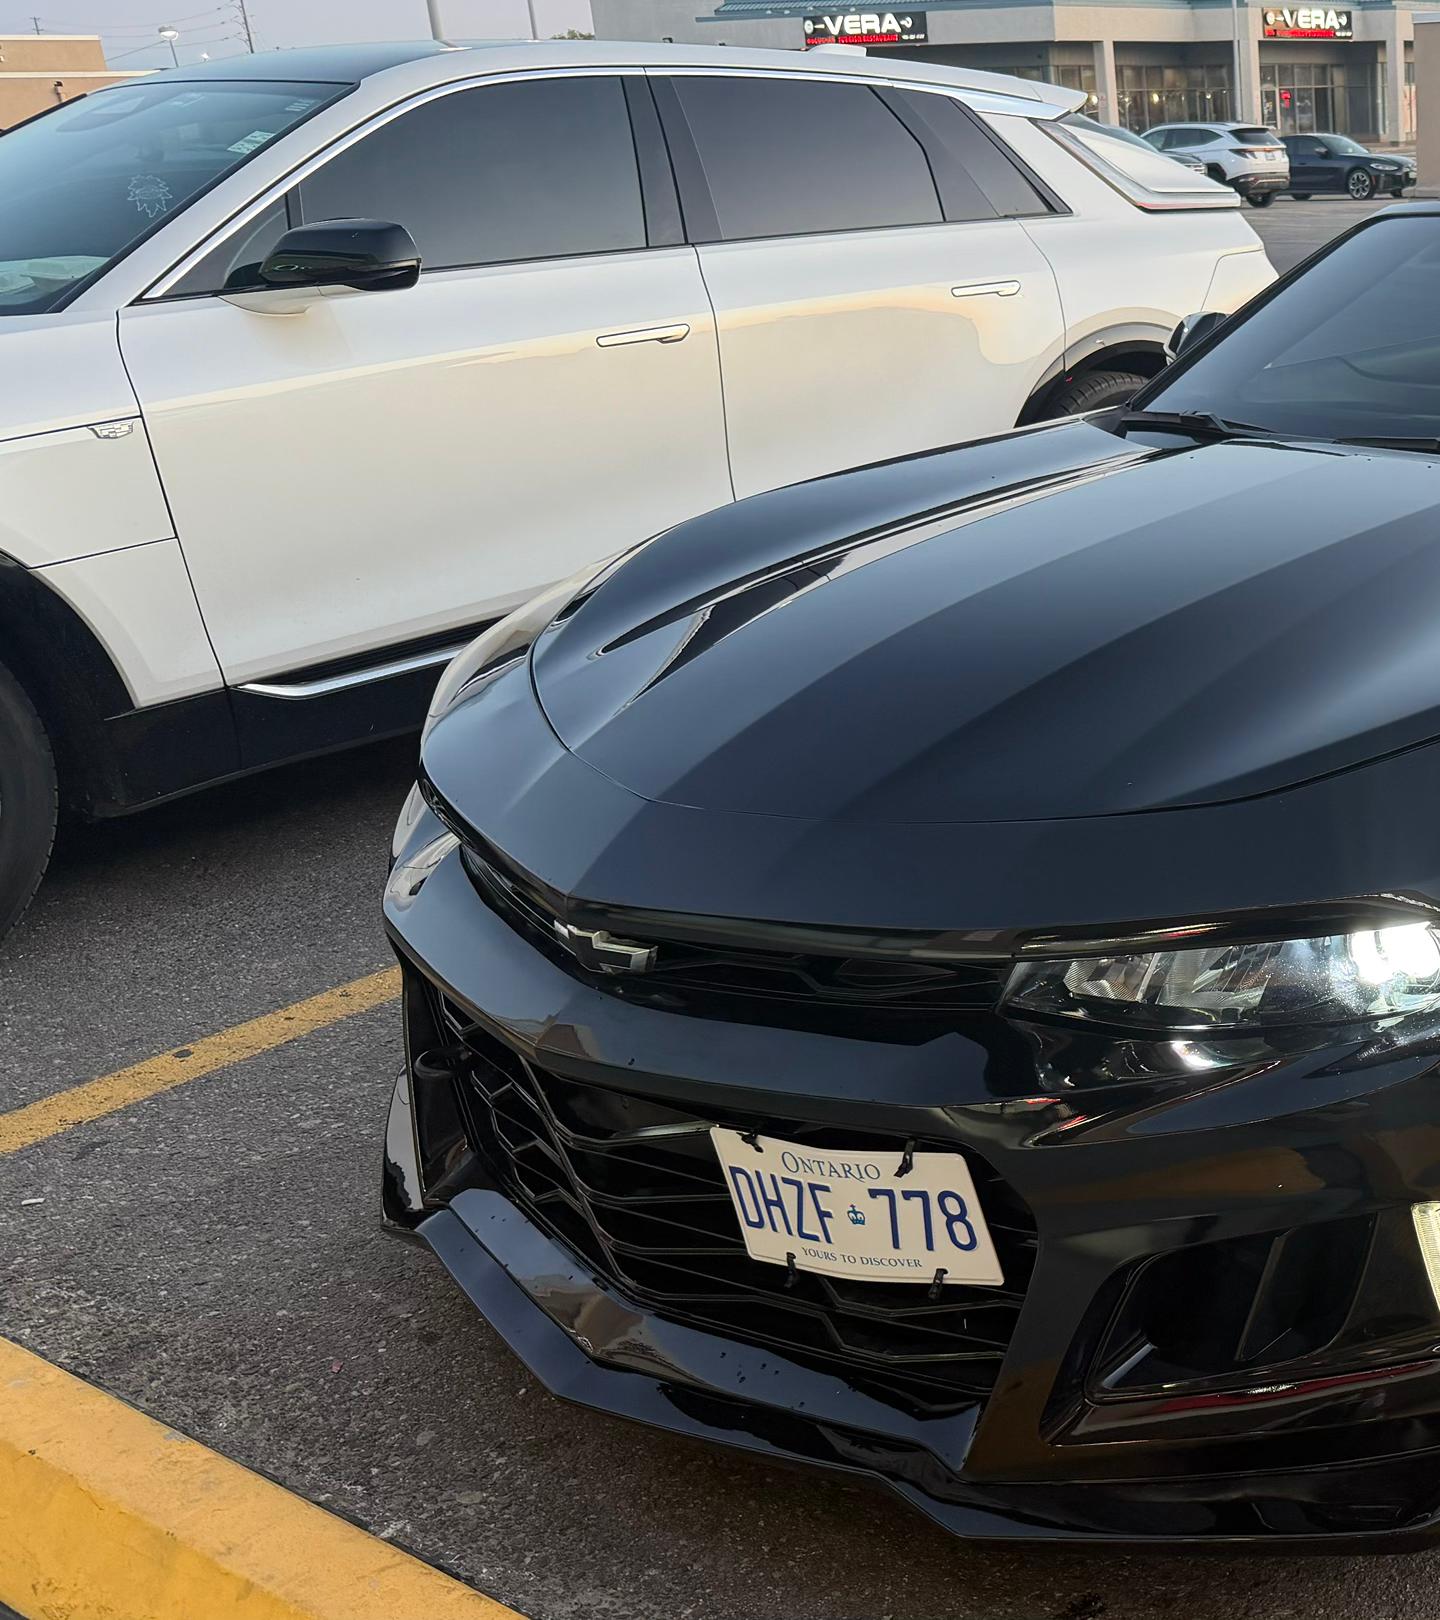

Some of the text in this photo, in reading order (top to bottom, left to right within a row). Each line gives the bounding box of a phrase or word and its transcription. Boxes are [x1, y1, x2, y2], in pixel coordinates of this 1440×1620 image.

[823, 13, 901, 35] VERA
[1282, 8, 1340, 29] VERA
[781, 1151, 881, 1183] ONTARIO
[729, 1165, 977, 1251] DHZF 778
[802, 1247, 922, 1268] YOURS TO DISCOVER
